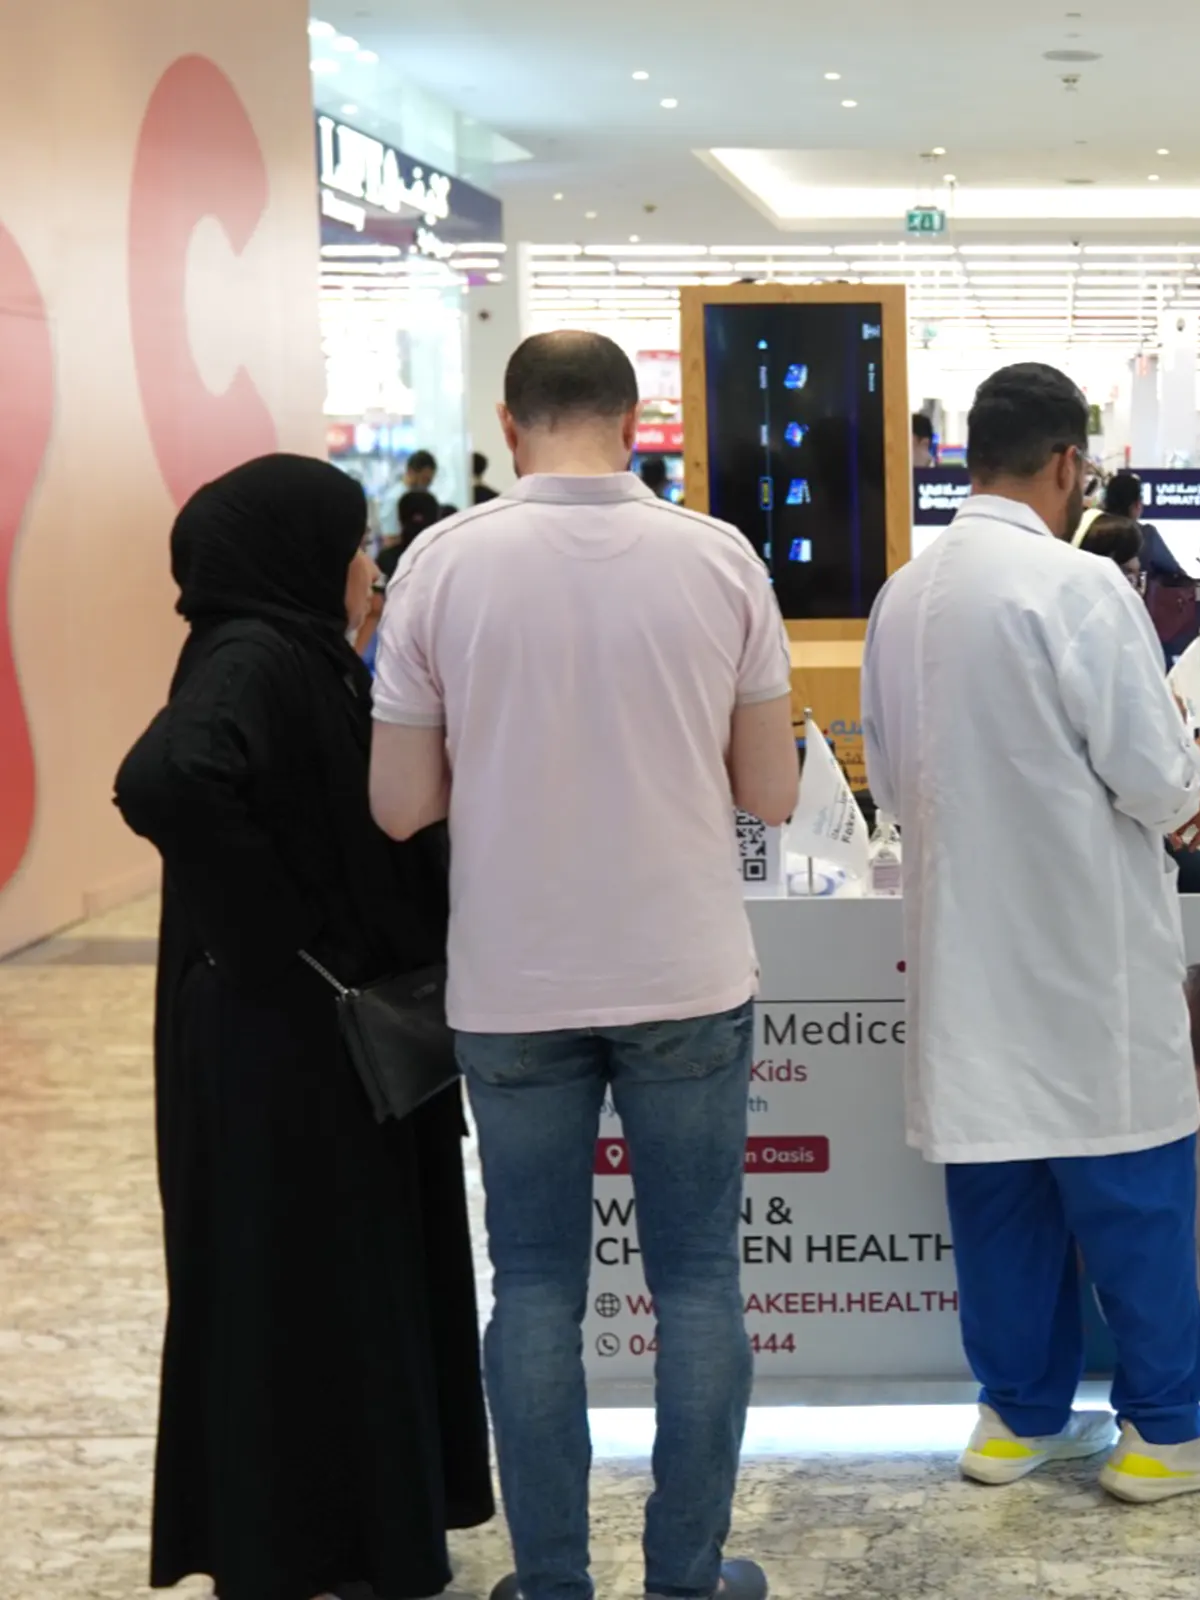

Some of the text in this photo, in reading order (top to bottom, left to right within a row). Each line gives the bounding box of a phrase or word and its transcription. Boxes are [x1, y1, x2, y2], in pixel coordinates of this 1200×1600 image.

[749, 1059, 808, 1083] Kids
[762, 1146, 815, 1164] Oasis
[766, 1196, 793, 1226] &
